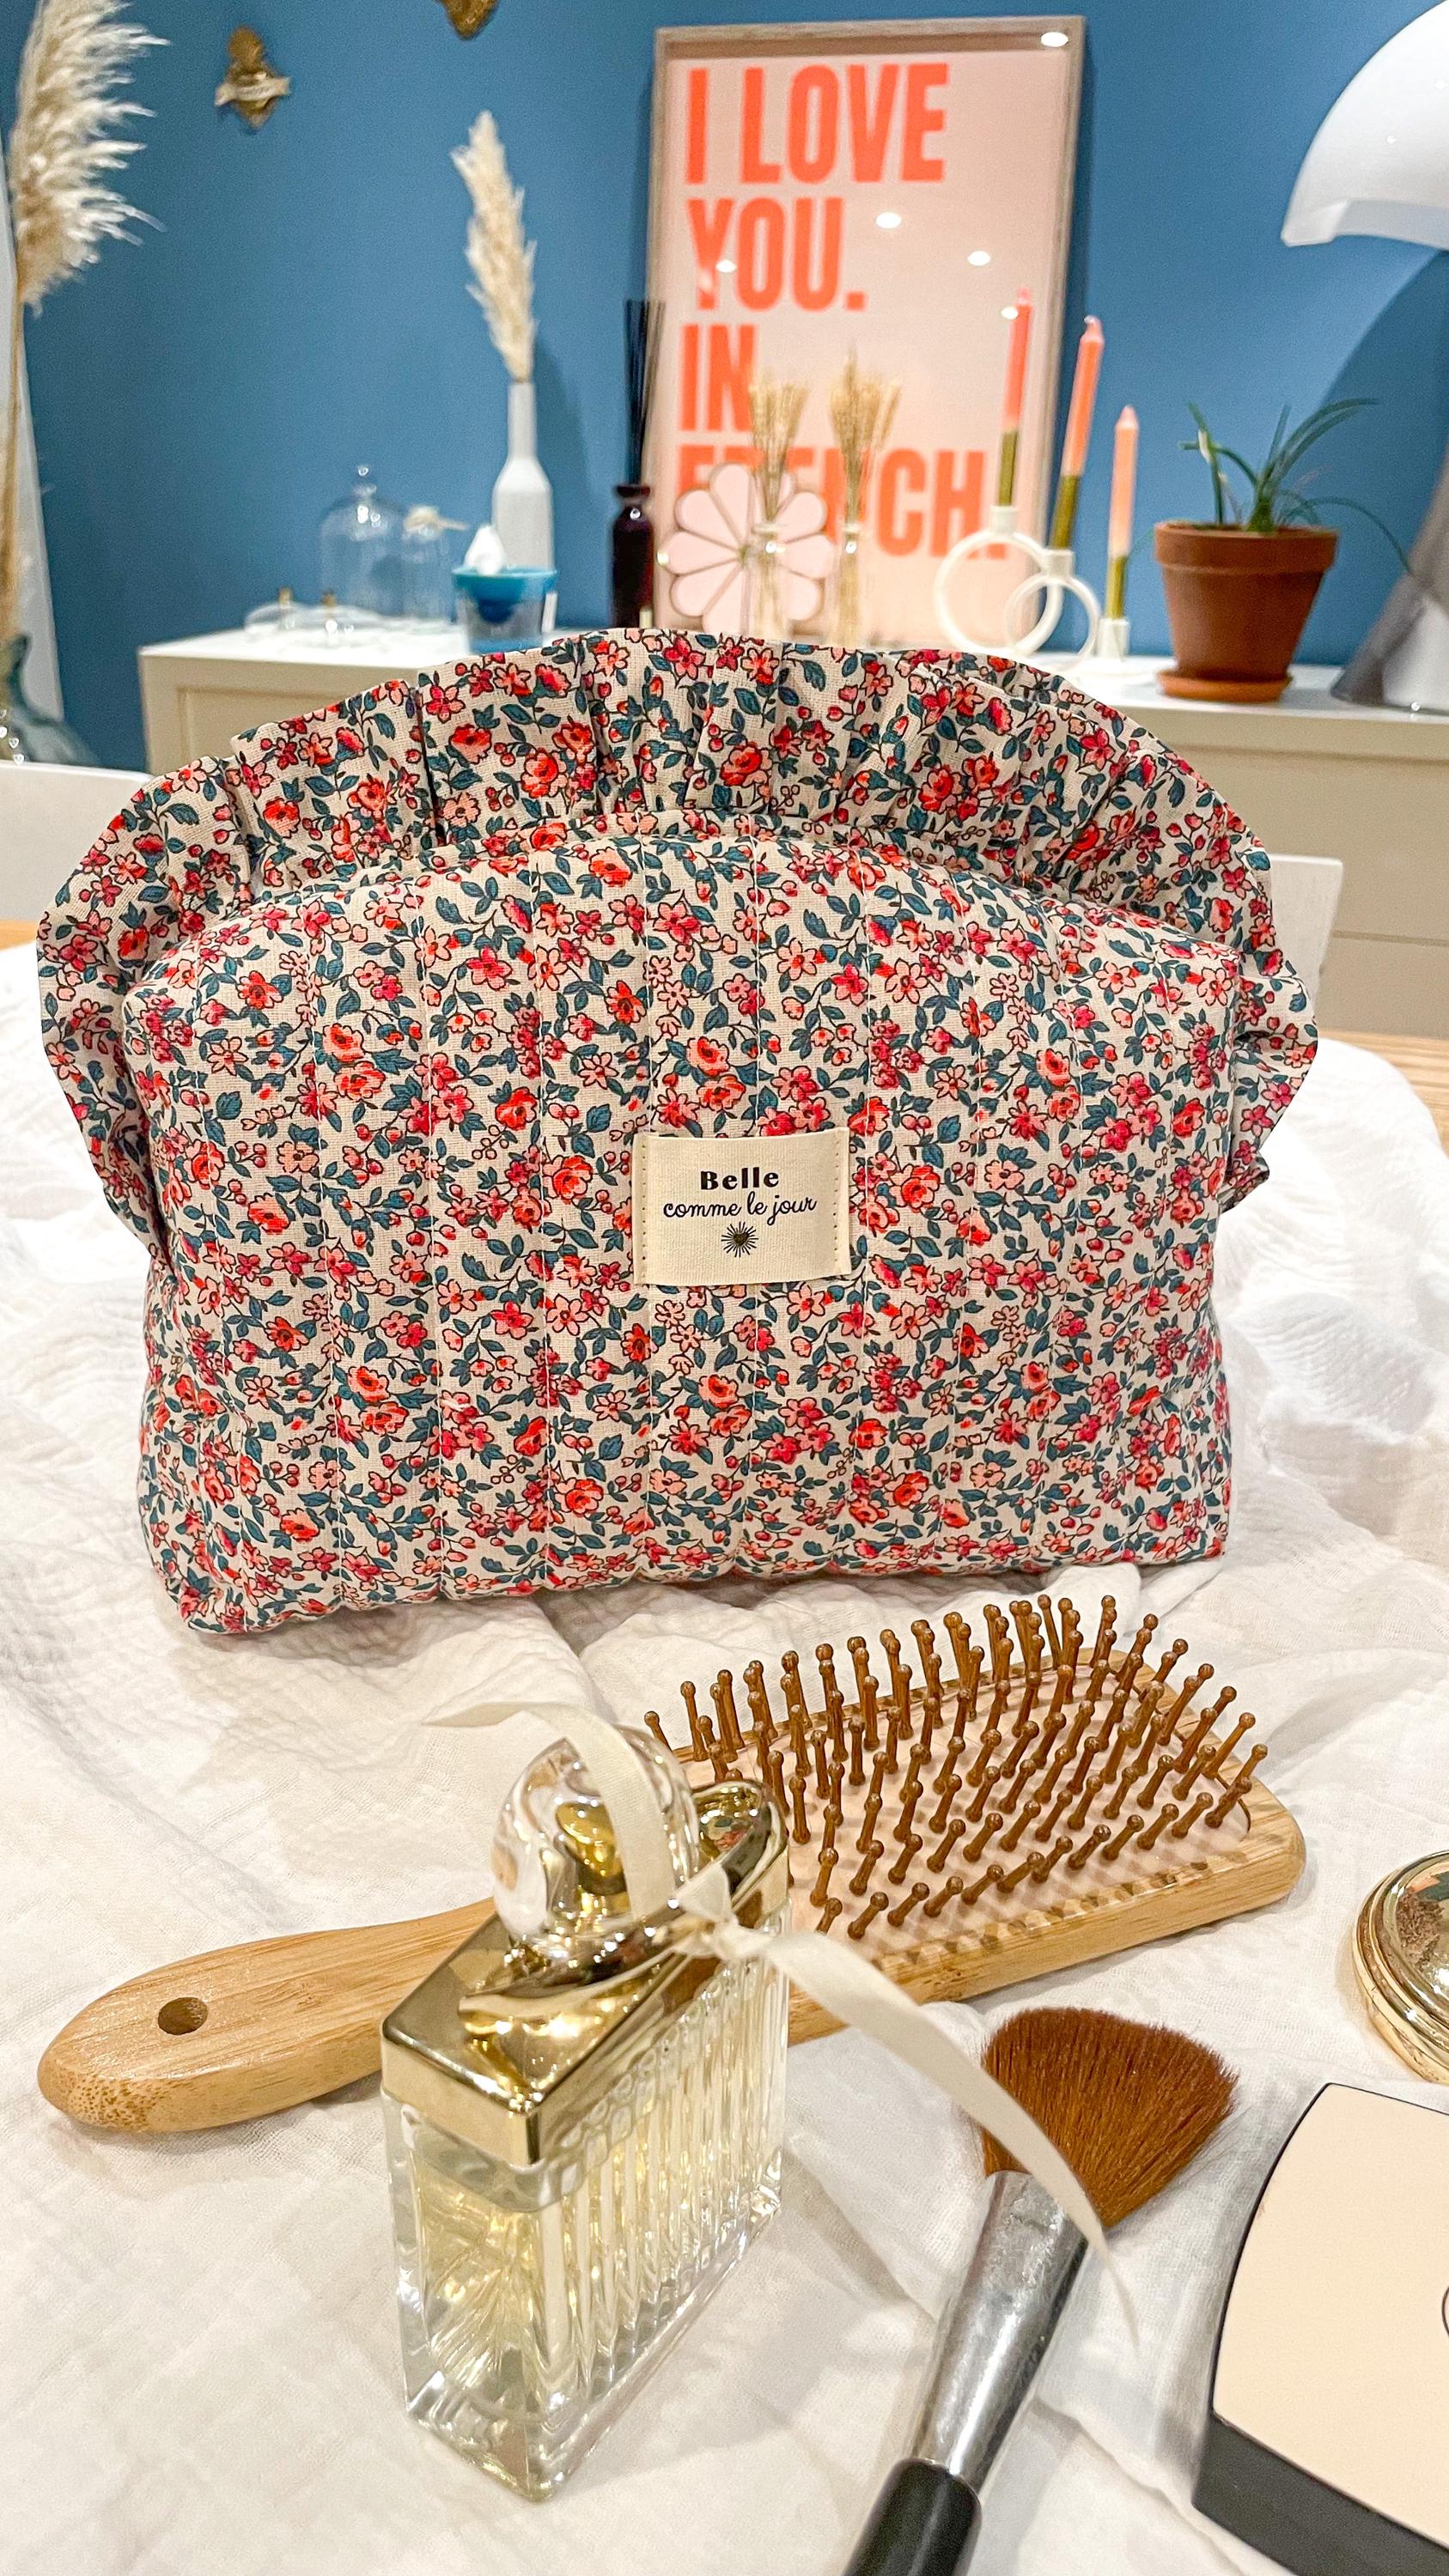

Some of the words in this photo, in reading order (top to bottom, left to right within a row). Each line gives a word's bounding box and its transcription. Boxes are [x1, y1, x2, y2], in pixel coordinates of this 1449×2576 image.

[688, 67, 709, 184] I
[741, 64, 947, 183] LOVE
[687, 197, 866, 311] YOU.
[681, 323, 754, 431] IN
[678, 444, 1008, 559] NCH.
[663, 1203, 742, 1218] comme
[746, 1191, 767, 1215] le
[767, 1194, 817, 1225] jour
[700, 1167, 779, 1190] Belle
